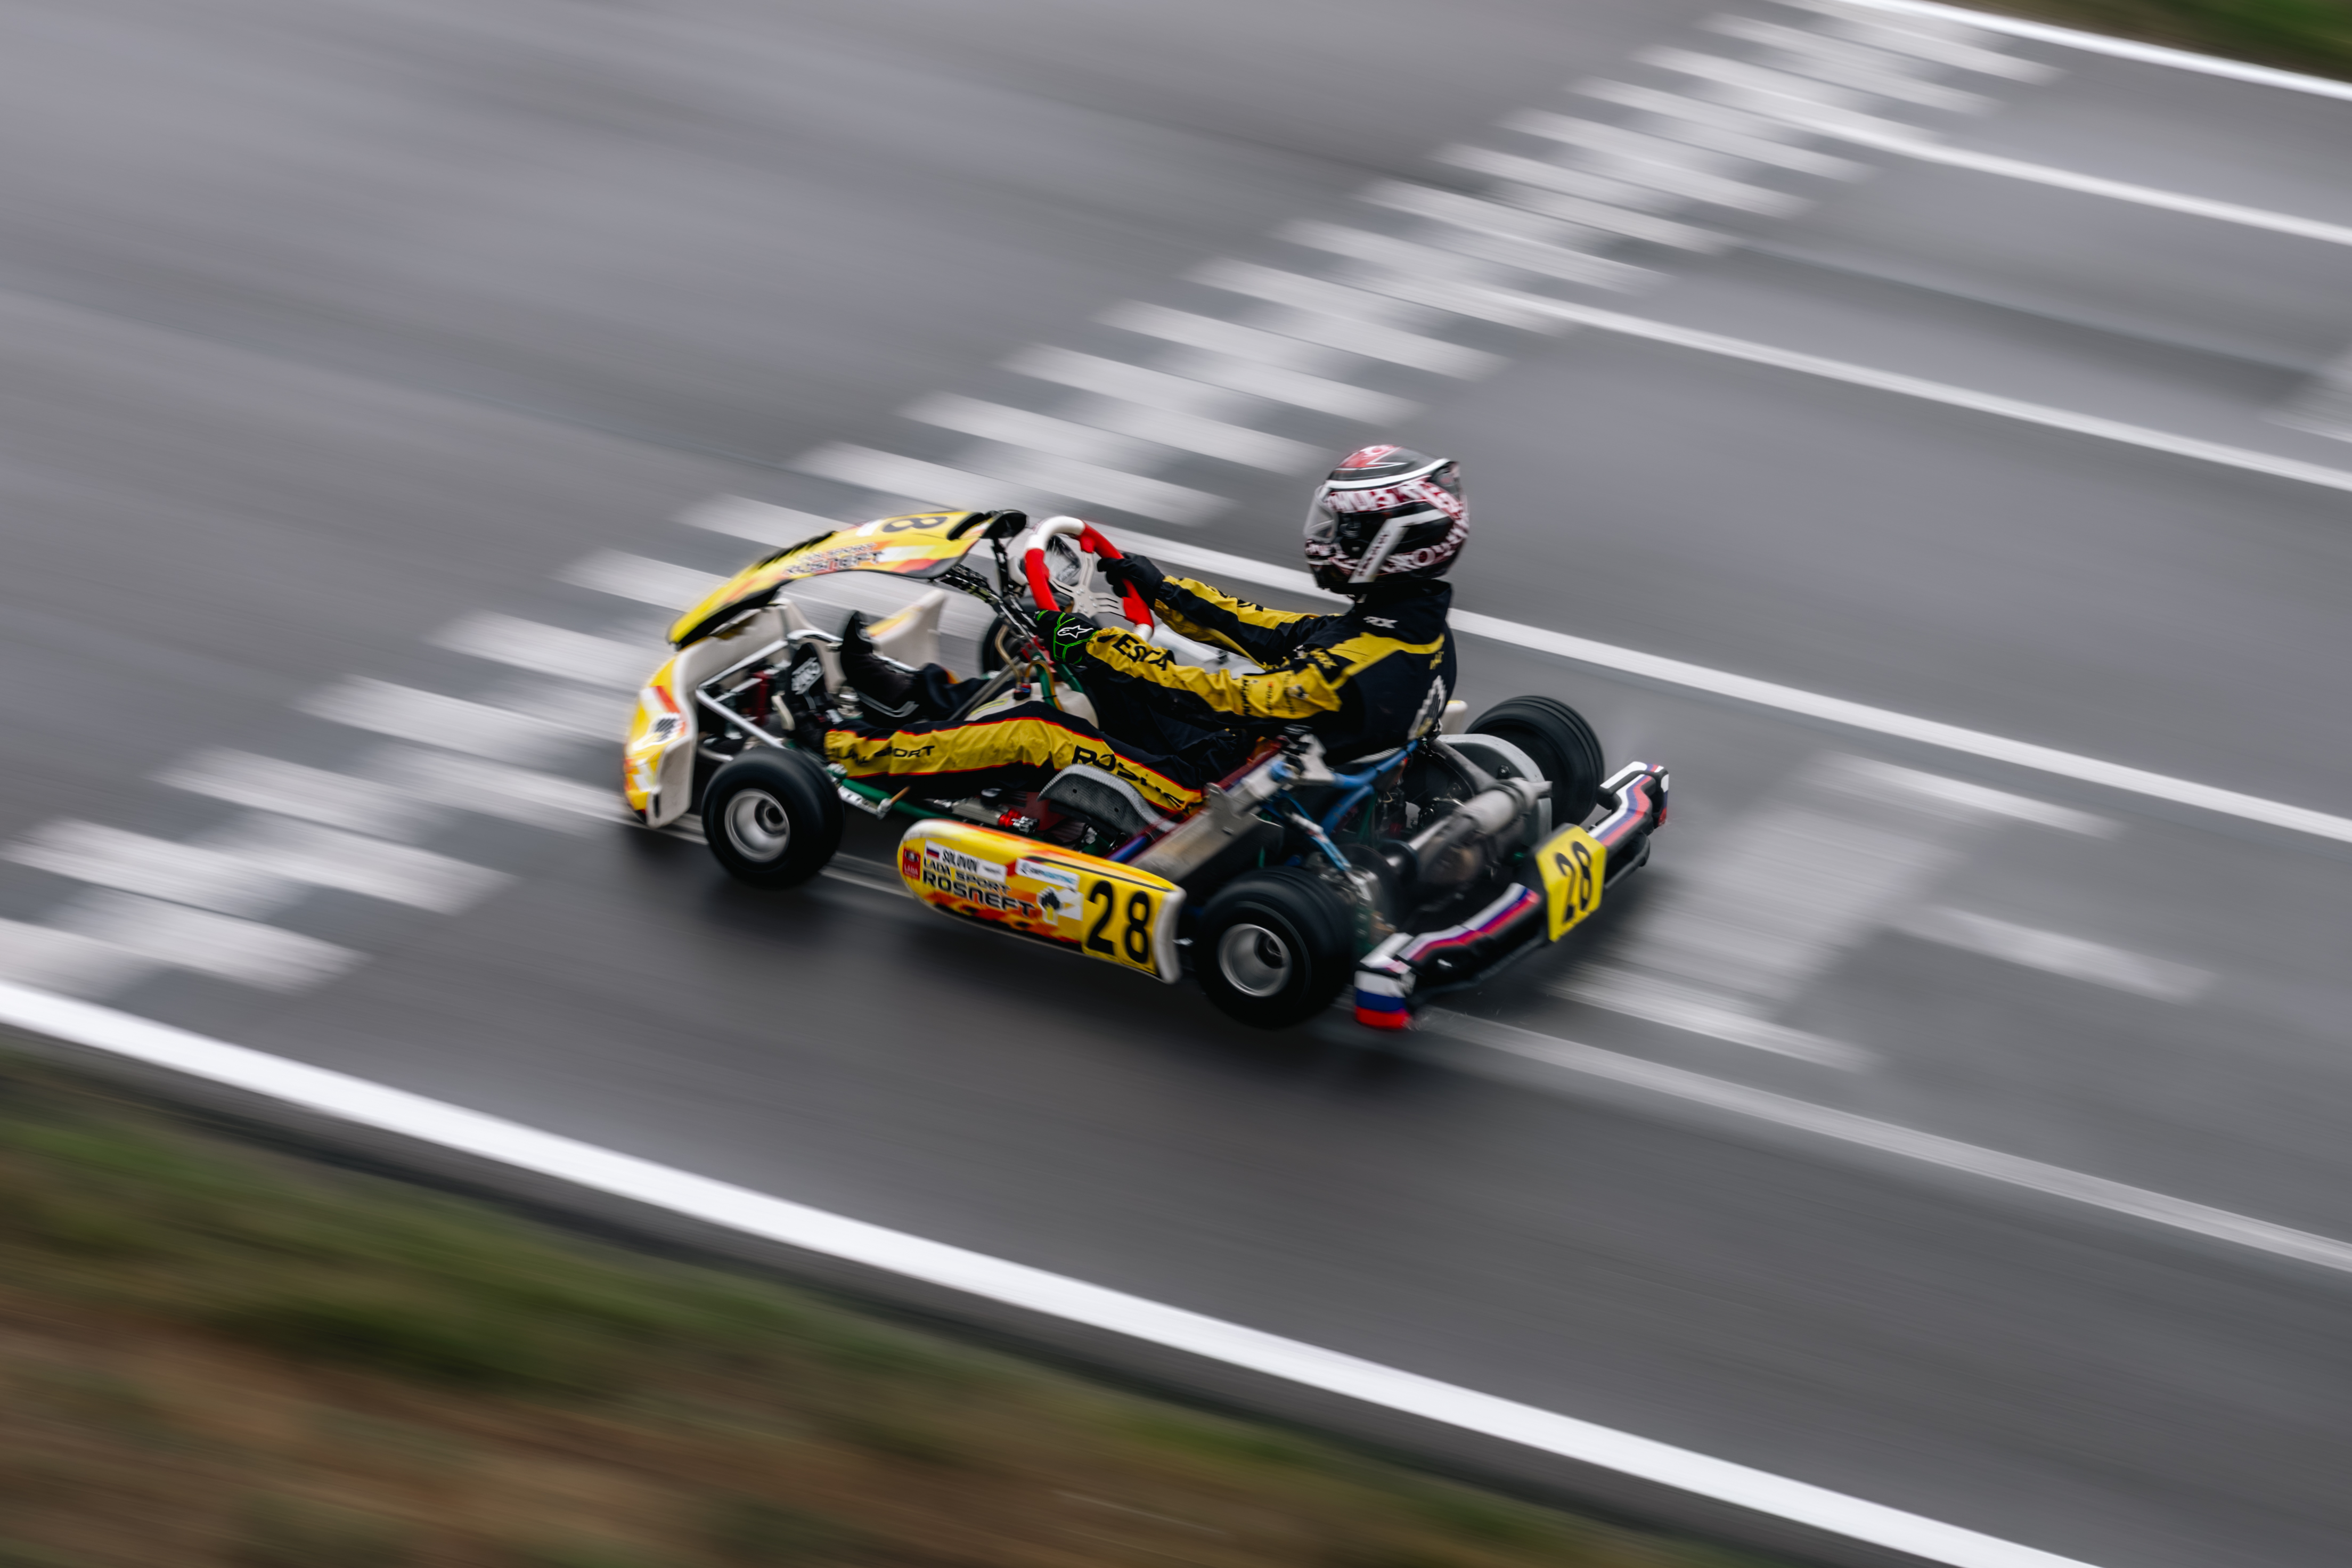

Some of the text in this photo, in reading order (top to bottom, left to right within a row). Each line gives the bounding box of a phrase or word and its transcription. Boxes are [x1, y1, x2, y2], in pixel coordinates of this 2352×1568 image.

[922, 870, 1035, 918] ROSNEFT
[923, 858, 951, 877] LADA
[954, 871, 1011, 895] SPORT
[1554, 840, 1592, 925] 28
[1087, 880, 1150, 963] 28
